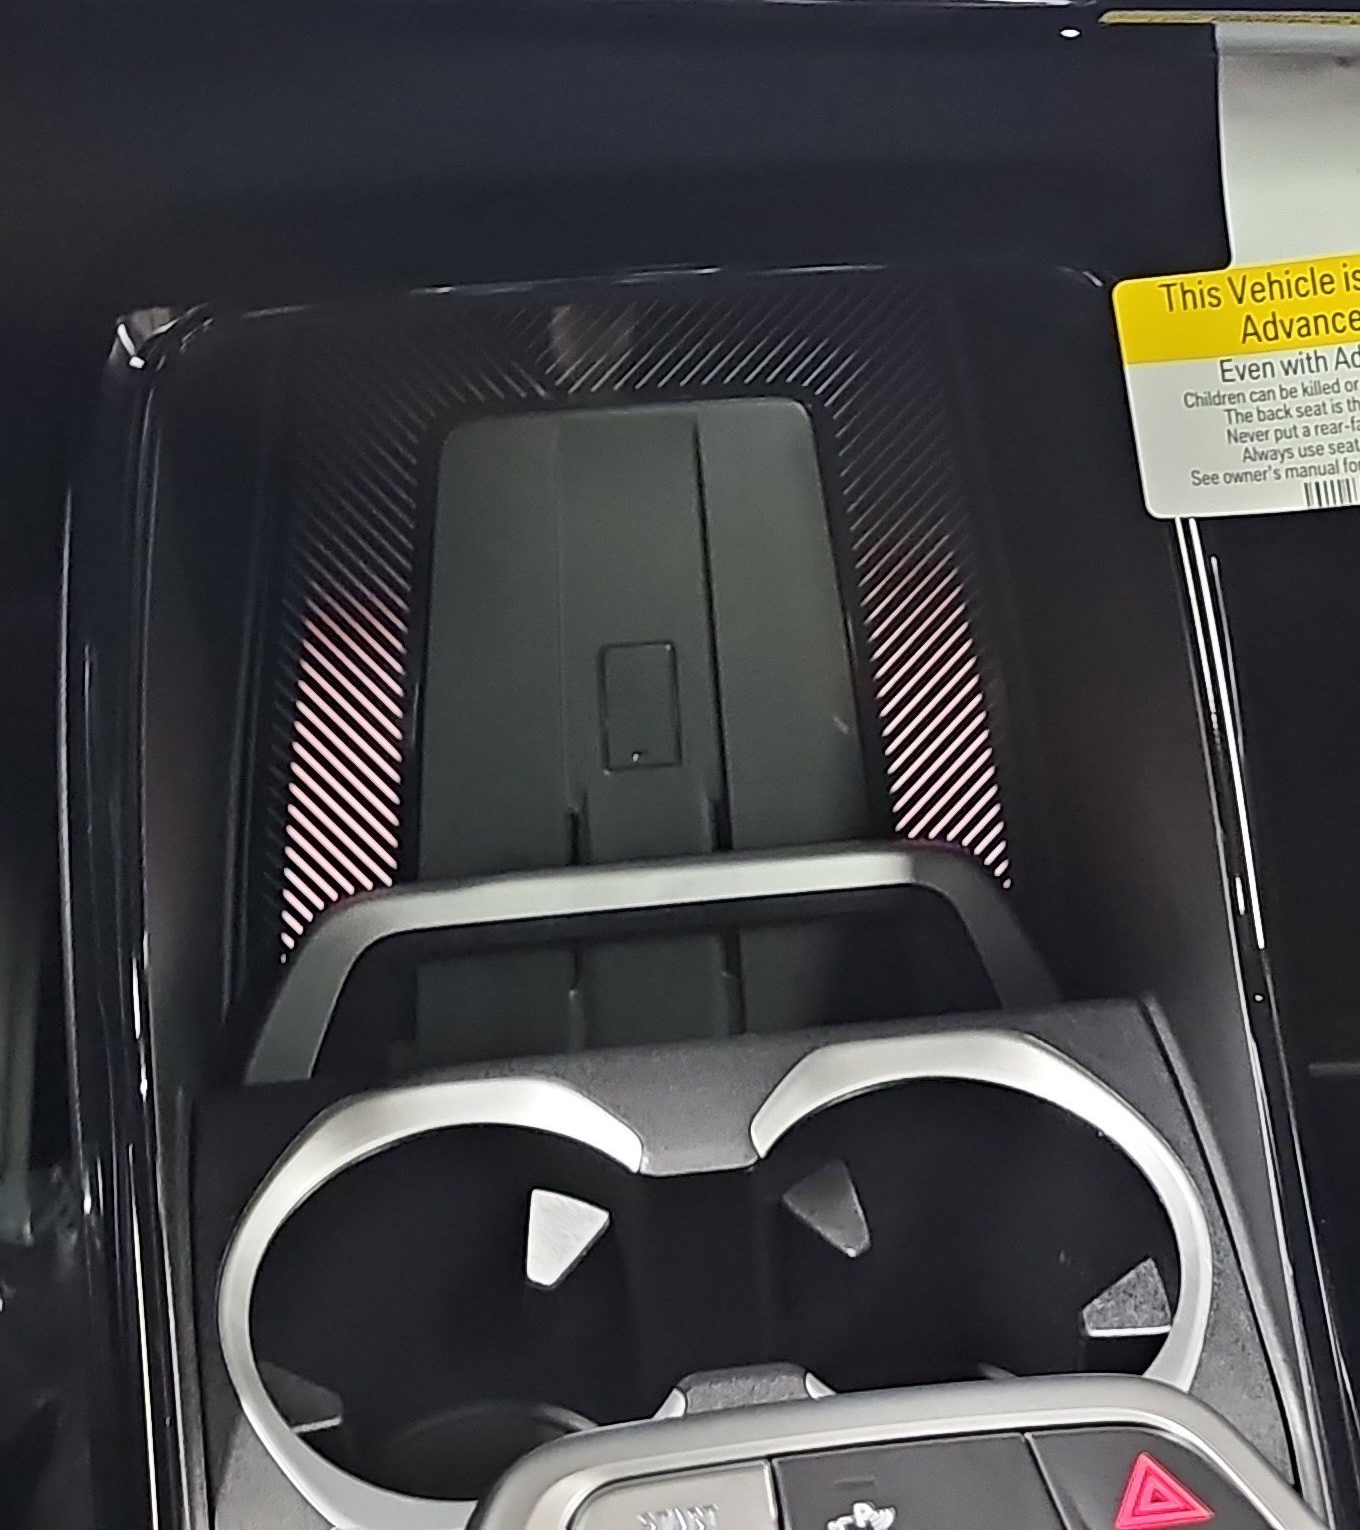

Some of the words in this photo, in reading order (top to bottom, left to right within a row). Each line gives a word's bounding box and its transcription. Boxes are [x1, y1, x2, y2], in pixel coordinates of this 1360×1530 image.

[1158, 279, 1222, 312] This
[1227, 266, 1335, 304] Vehicle
[1219, 359, 1275, 382] Even
[1280, 349, 1328, 376] with
[1184, 391, 1246, 408] Children
[1249, 388, 1276, 403] can
[1279, 384, 1298, 400] be
[1301, 380, 1340, 397] killed
[1344, 379, 1359, 392] or
[1224, 408, 1253, 425] The
[1257, 404, 1293, 421] back
[1296, 401, 1327, 417] seat
[1331, 401, 1343, 414] is
[1227, 429, 1270, 444] Never
[1274, 426, 1300, 443] put
[1302, 425, 1311, 437] a
[1243, 447, 1294, 464] Always
[1298, 444, 1324, 458] use
[1328, 439, 1359, 455] seat
[1191, 470, 1220, 486] See
[1223, 465, 1281, 483] owner's
[1285, 460, 1339, 479] manual
